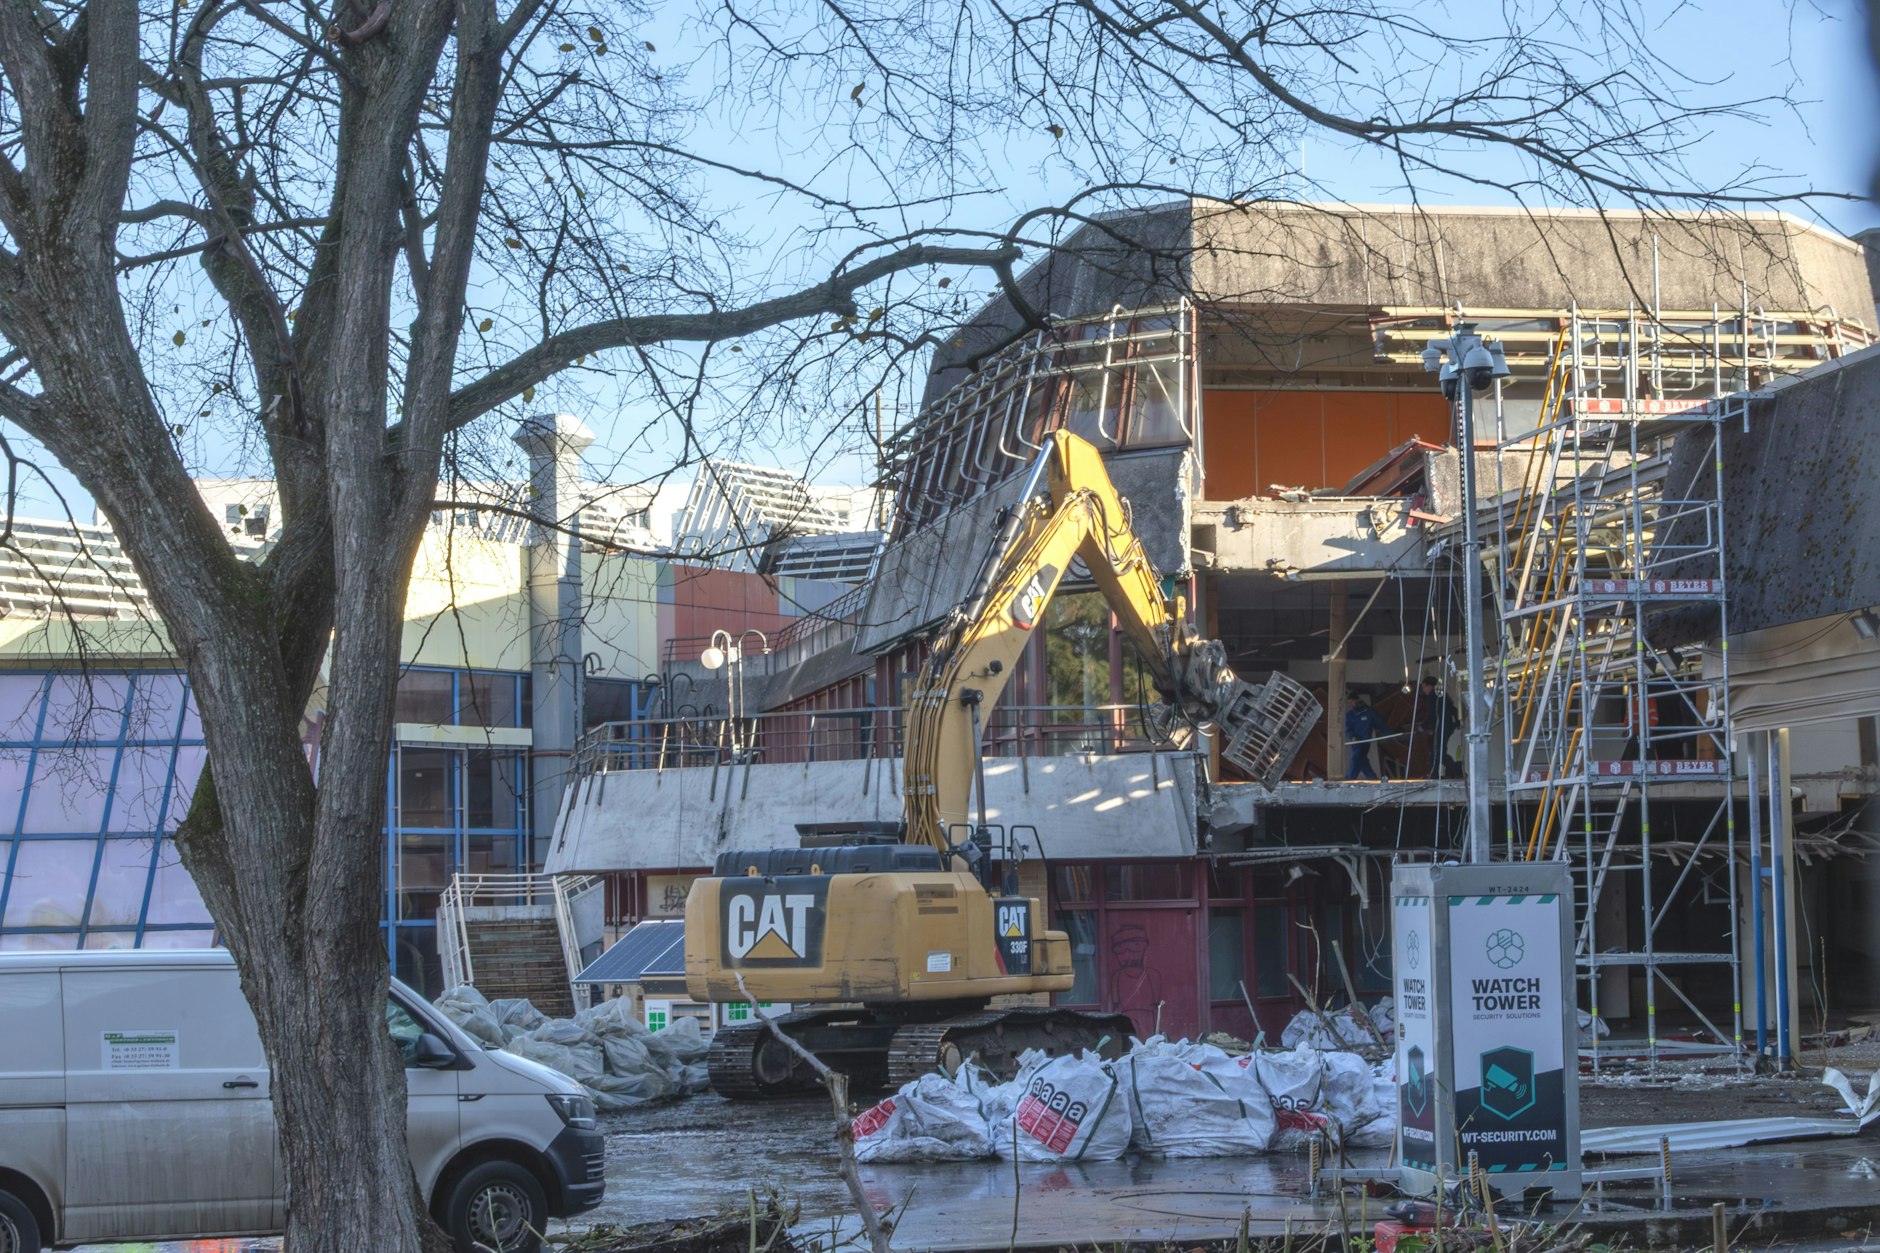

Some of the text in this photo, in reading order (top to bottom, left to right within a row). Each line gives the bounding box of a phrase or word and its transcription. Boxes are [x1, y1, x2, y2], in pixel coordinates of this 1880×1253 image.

[1665, 401, 1702, 410] BEYER
[1670, 581, 1708, 589] BEYER
[1021, 574, 1046, 619] CAT
[1676, 761, 1714, 770] BEYER
[728, 894, 815, 959] CAT
[999, 906, 1026, 937] CAT
[1010, 941, 1028, 954] 330F
[1403, 978, 1425, 995] WATCH
[1472, 978, 1540, 994] WATCH
[1403, 995, 1426, 1011] TOWER
[1472, 995, 1541, 1011] TOWER
[1462, 1129, 1557, 1143] WT-SECURITY.COM
